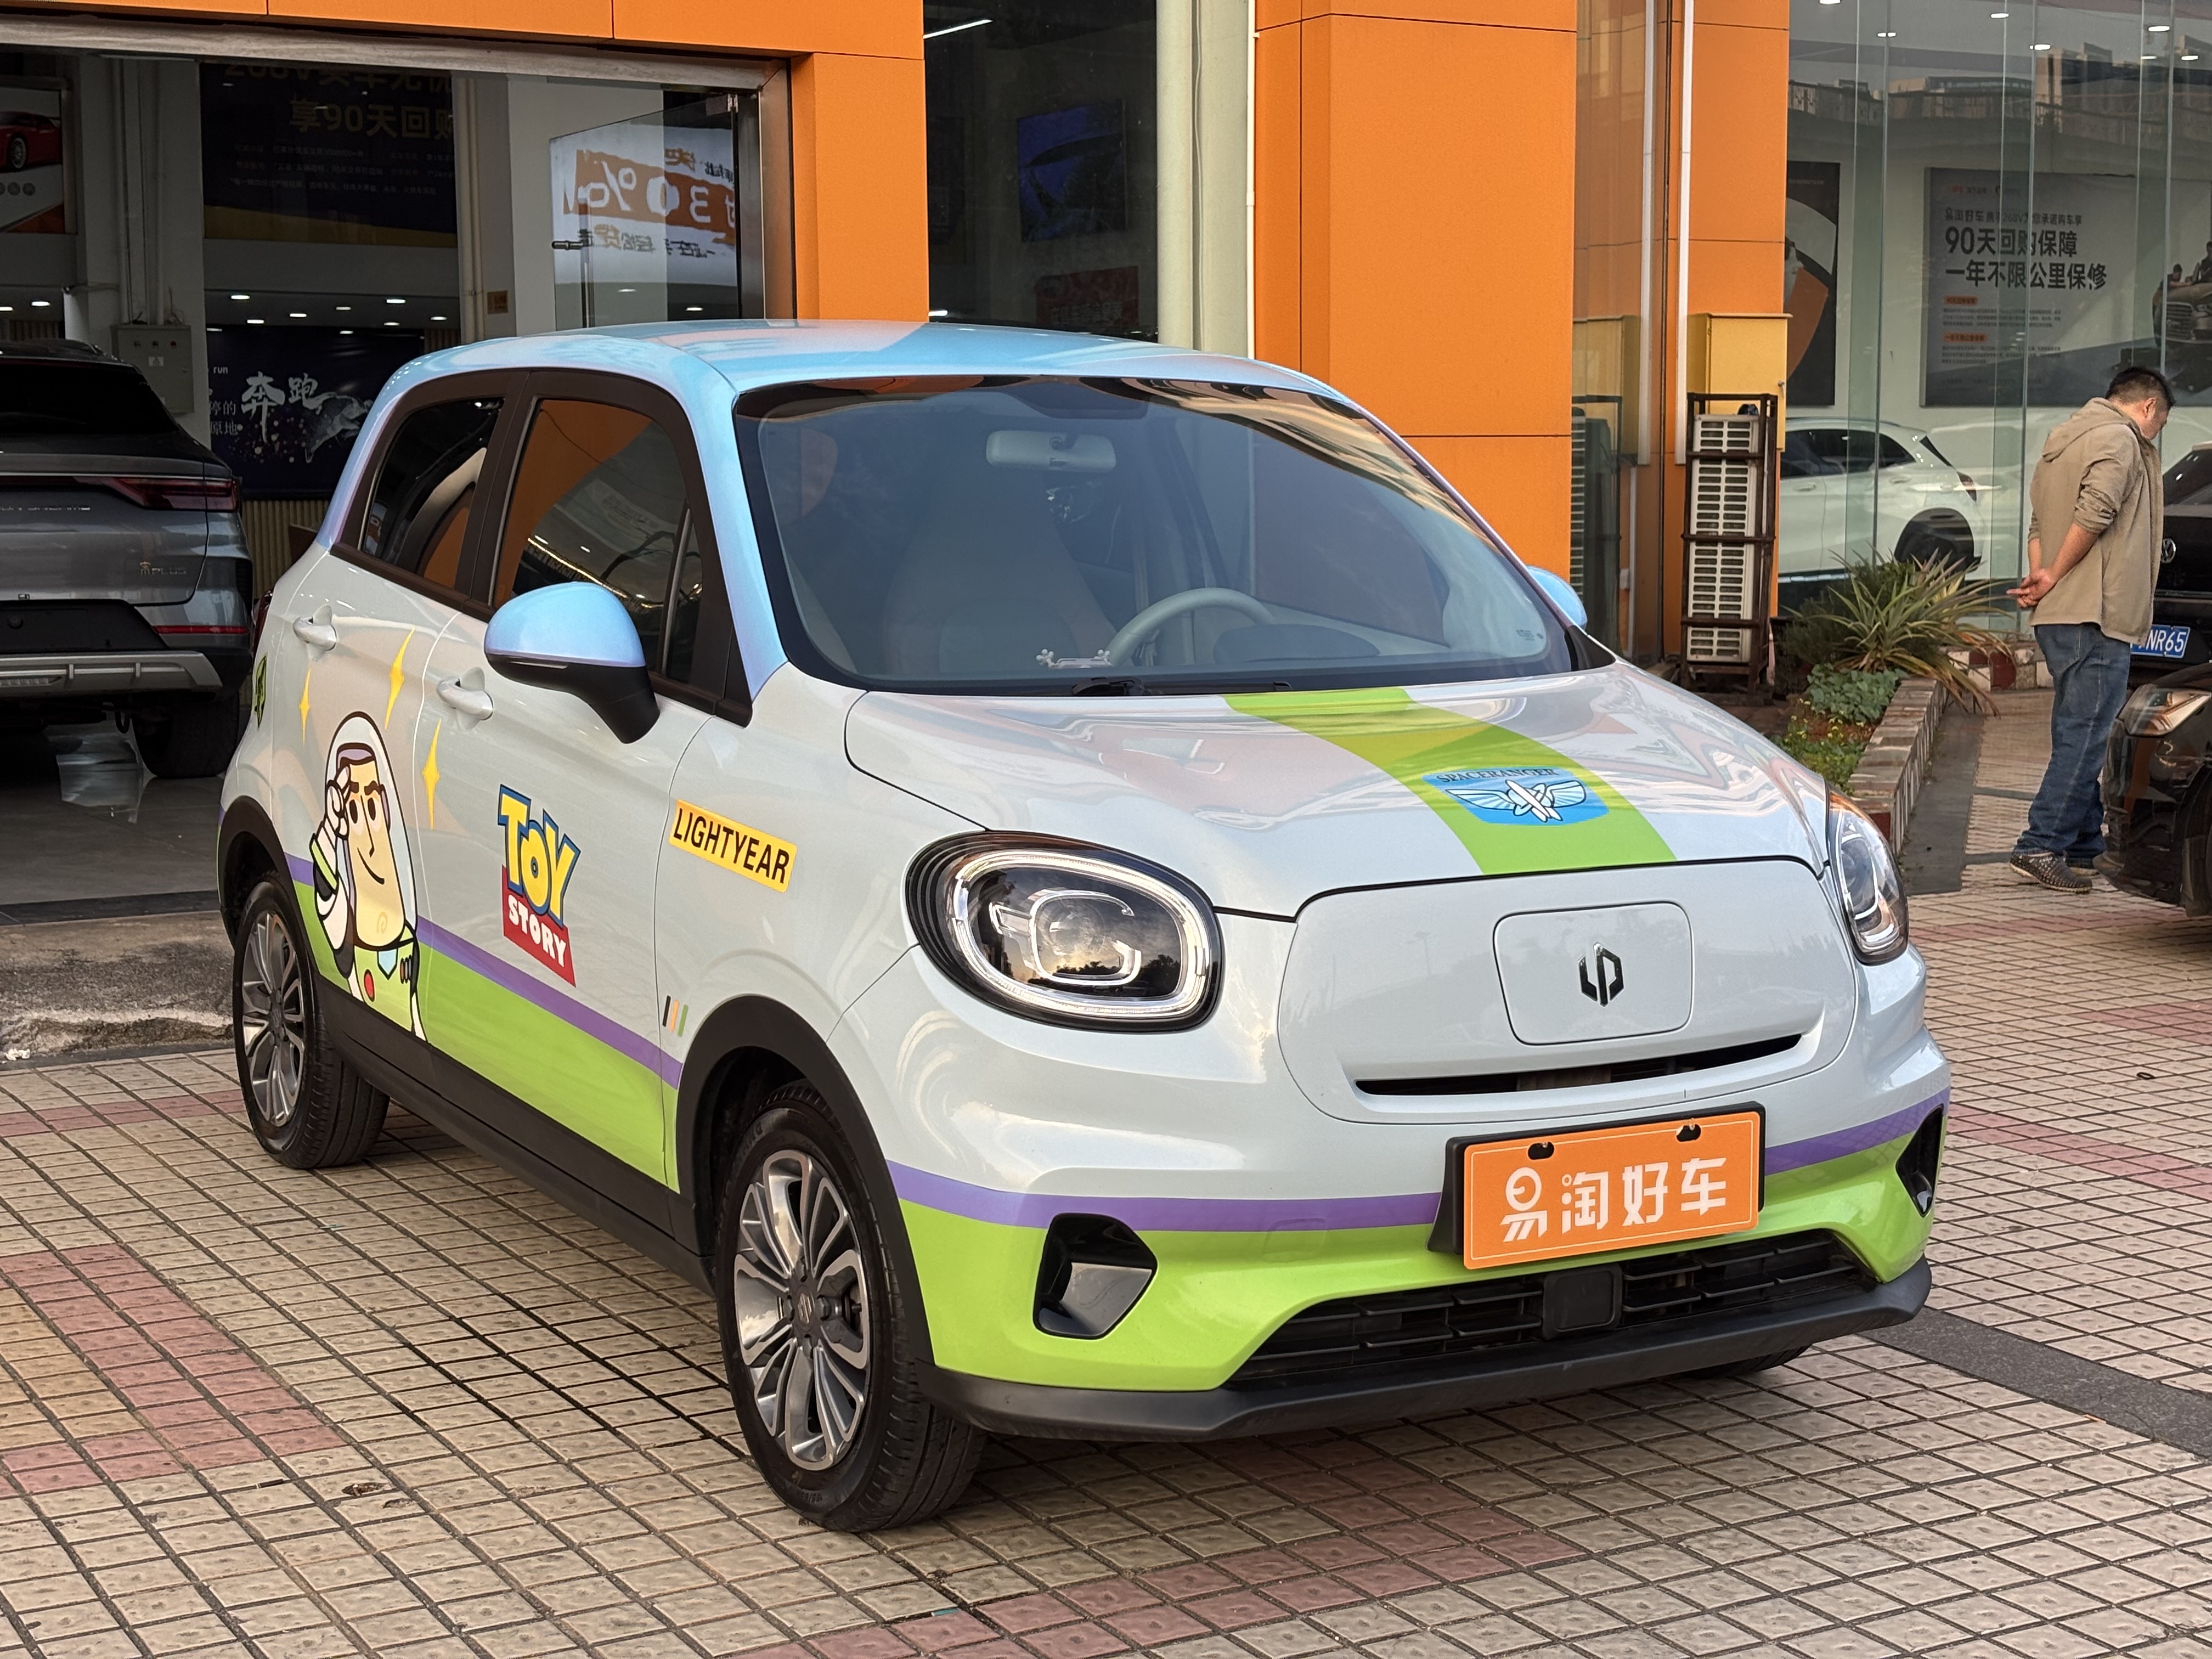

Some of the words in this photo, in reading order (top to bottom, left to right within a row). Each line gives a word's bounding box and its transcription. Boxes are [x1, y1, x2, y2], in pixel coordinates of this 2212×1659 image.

[1945, 227, 2078, 257] 90天回购保障
[1945, 259, 2107, 290] 一年不限公里保修
[241, 371, 324, 443] 奔跑
[498, 784, 581, 927] TOY
[673, 808, 790, 883] LIGHTYEAR
[507, 894, 566, 967] STORY
[1499, 1157, 1726, 1243] 易淘好车
